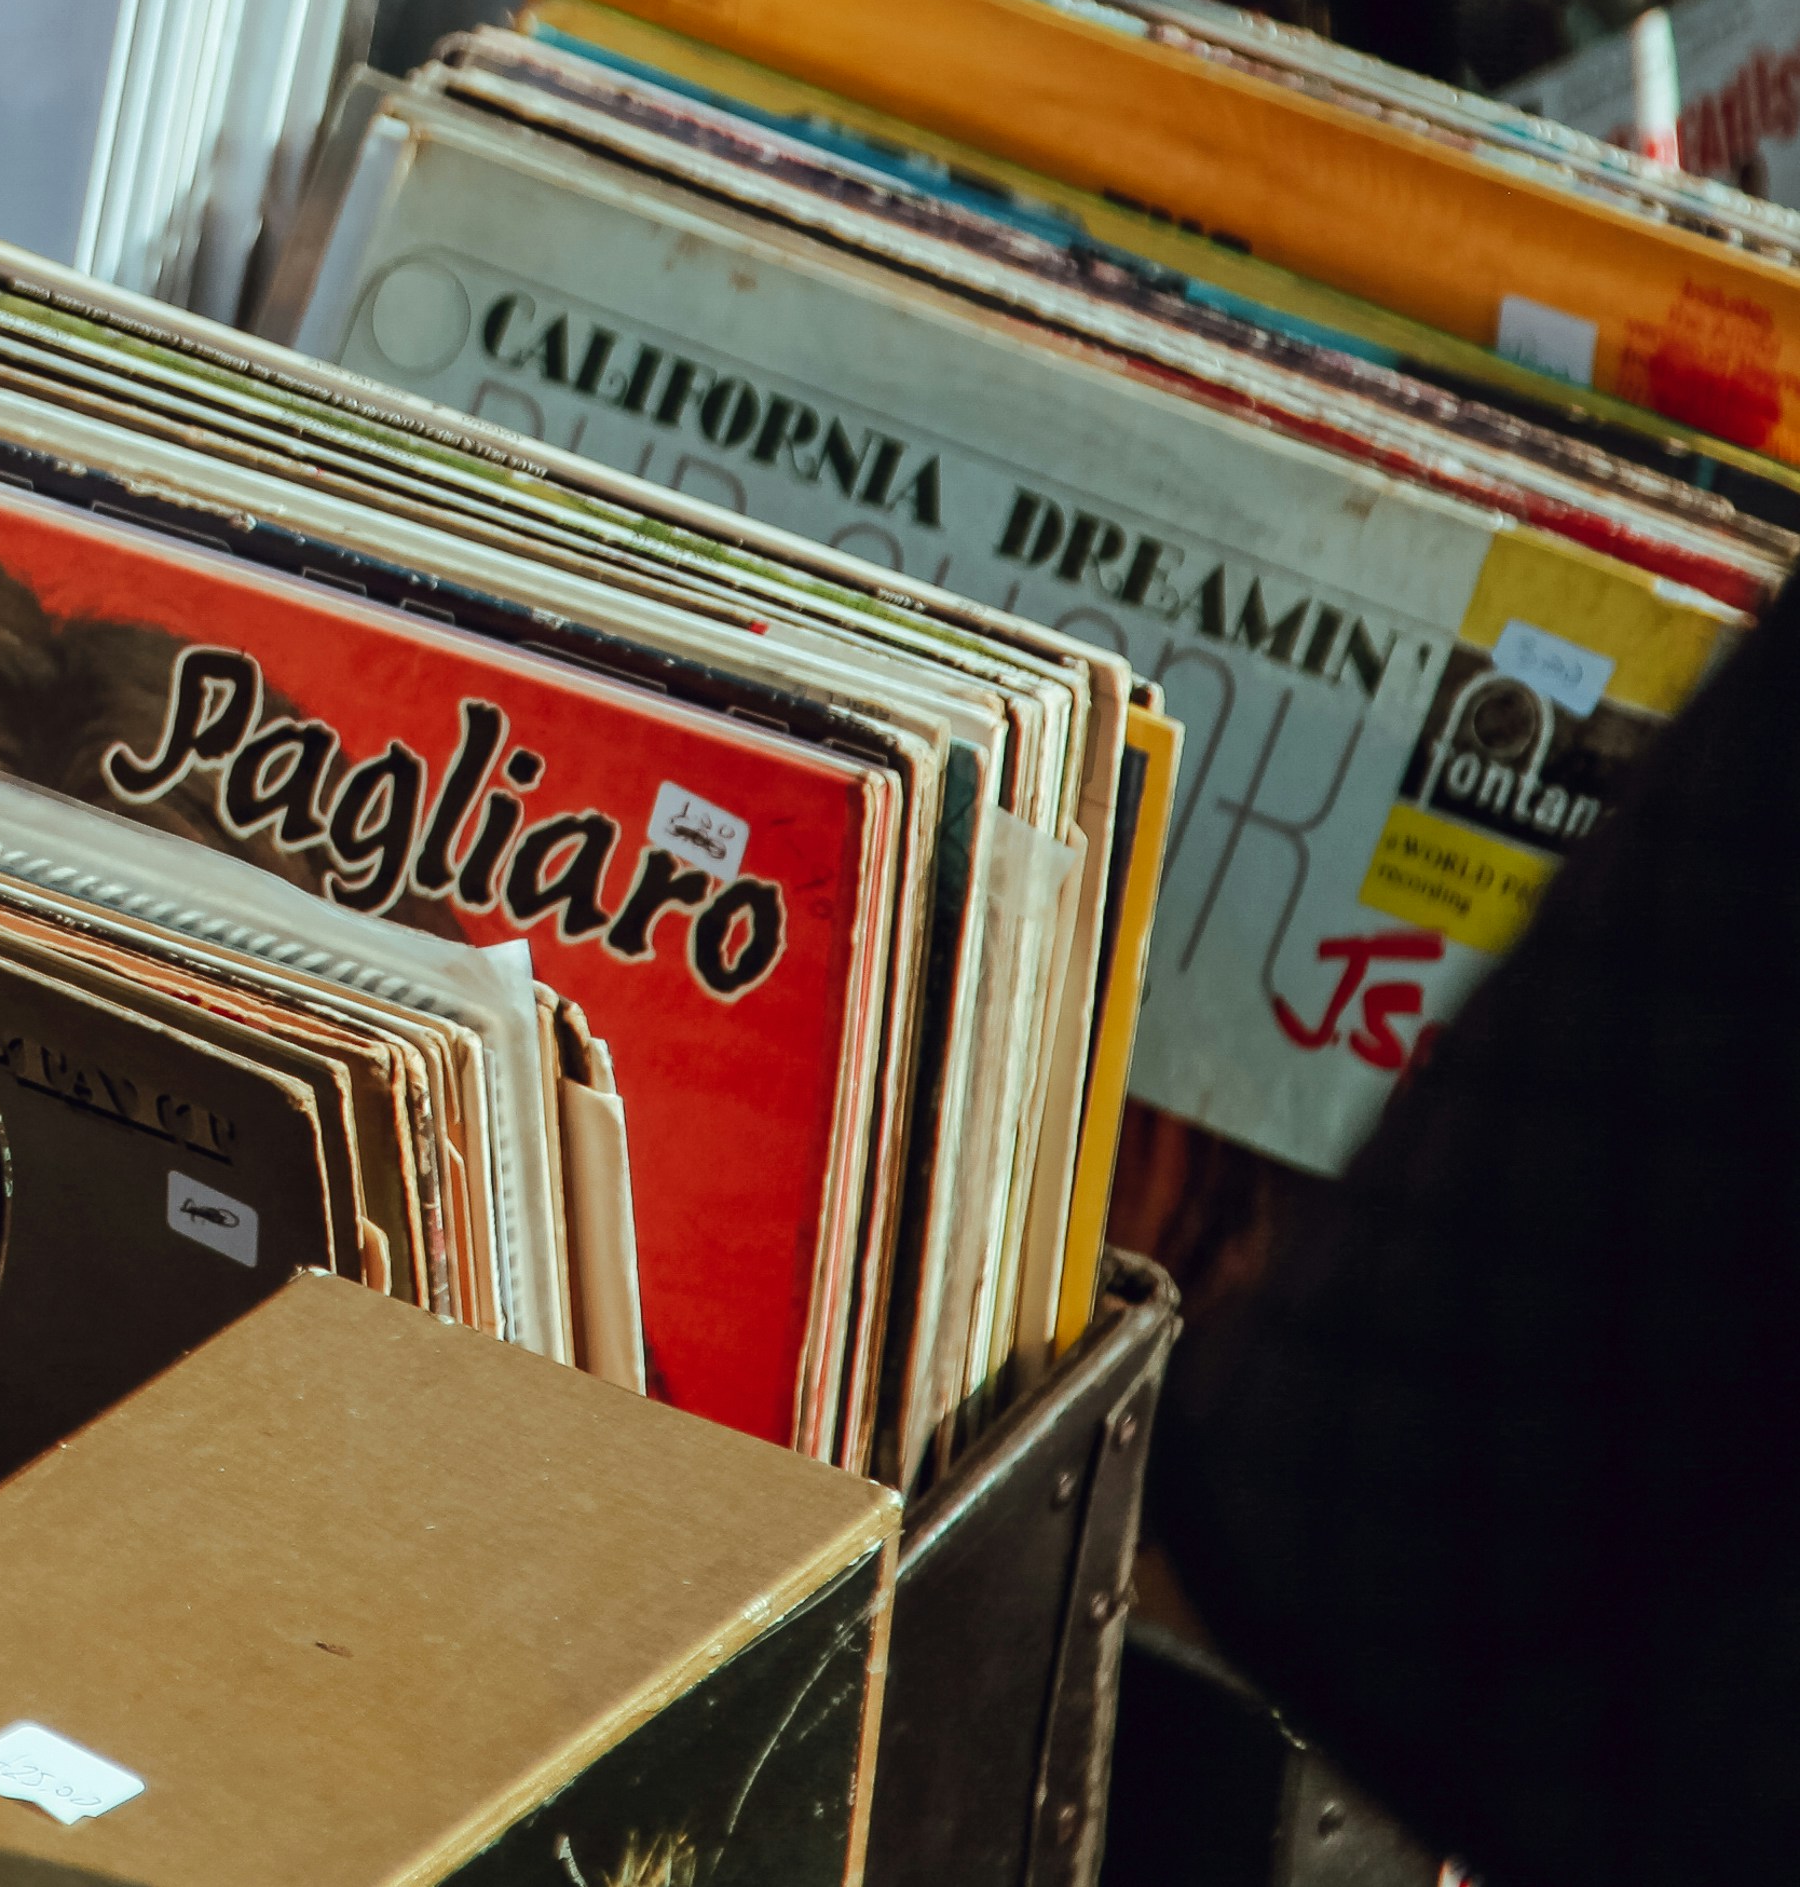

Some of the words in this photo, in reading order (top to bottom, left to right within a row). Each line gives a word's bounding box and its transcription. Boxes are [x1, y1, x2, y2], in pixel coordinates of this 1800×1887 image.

[481, 292, 943, 529] CALIFORNIA
[103, 643, 788, 1003] Pagliaro
[1402, 830, 1495, 889] WORLD
